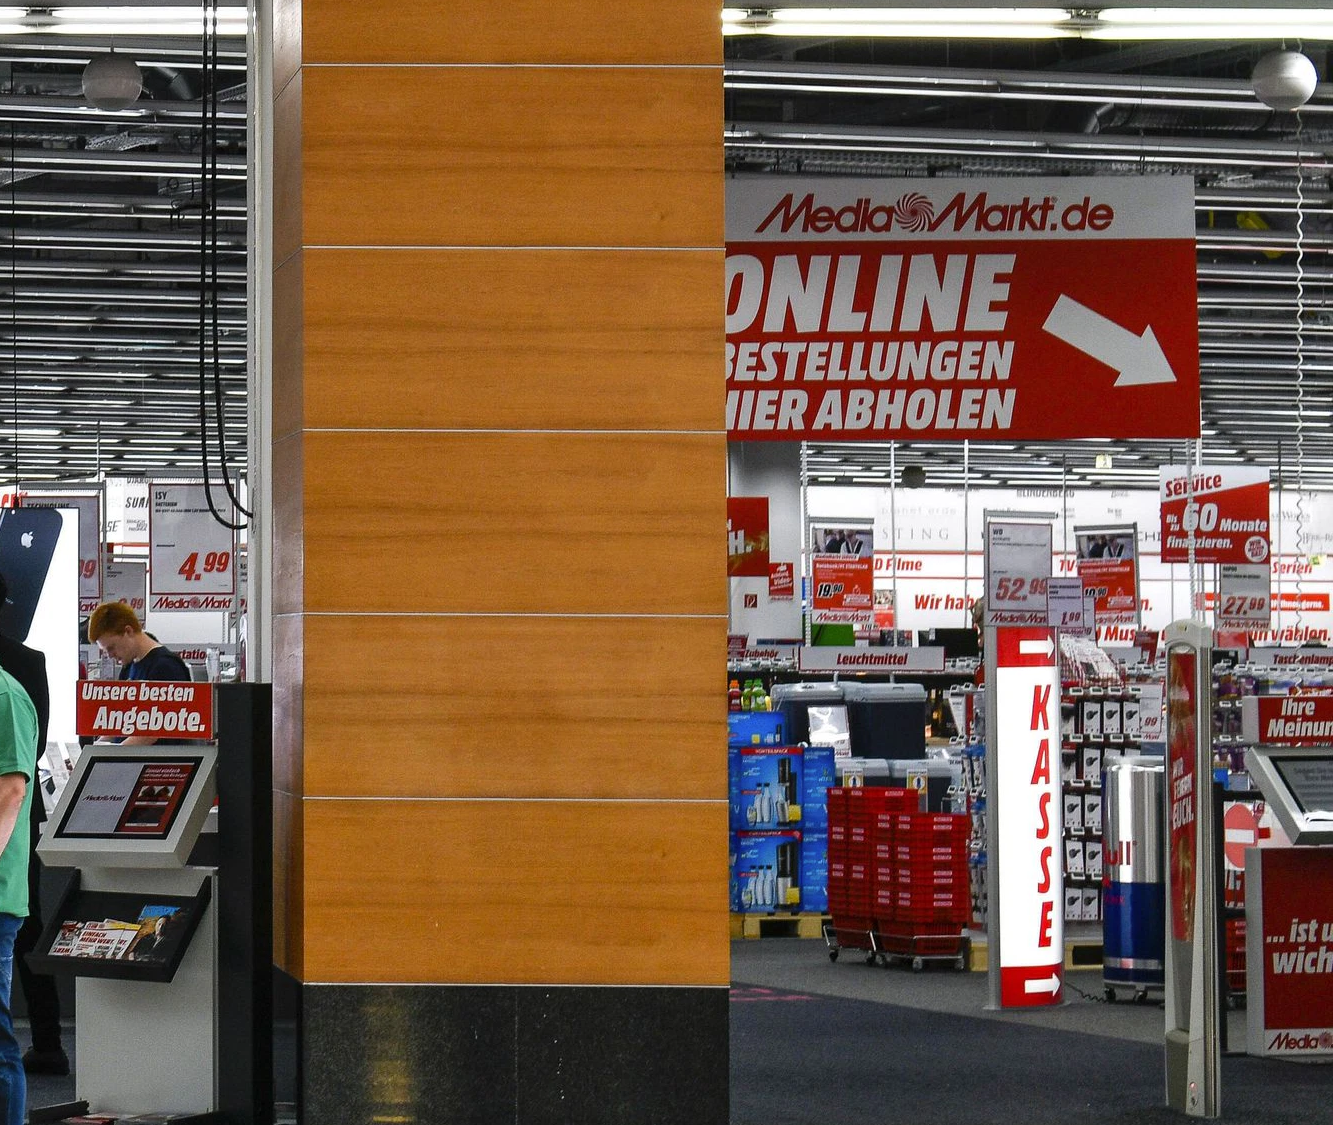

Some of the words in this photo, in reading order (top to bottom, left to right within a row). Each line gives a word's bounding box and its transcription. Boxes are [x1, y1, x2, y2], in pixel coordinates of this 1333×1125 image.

[725, 253, 1017, 334] ONLINE
[811, 387, 1017, 431] ABHOLEN
[1166, 473, 1222, 497] Service
[155, 491, 167, 500] ISY
[1183, 502, 1218, 532] 60
[1220, 518, 1268, 532] Monate
[178, 551, 230, 581] 4.99
[886, 557, 922, 571] Flme
[996, 577, 1046, 601] 52.99
[914, 593, 940, 610] Wir
[1222, 596, 1266, 615] 27.99
[1270, 626, 1330, 642] wählen.
[743, 649, 779, 659] Zubehör
[836, 652, 908, 666] Leuchtmittel
[1273, 654, 1333, 666] Taschenlamp
[82, 682, 136, 701] Unsere
[139, 683, 194, 702] besten
[1281, 698, 1316, 716] Ihre
[93, 706, 206, 735] Angebote.
[1267, 718, 1333, 737] Meinun
[1030, 684, 1054, 948] KASSE
[1289, 917, 1317, 943] ist
[1272, 945, 1333, 974] wich
